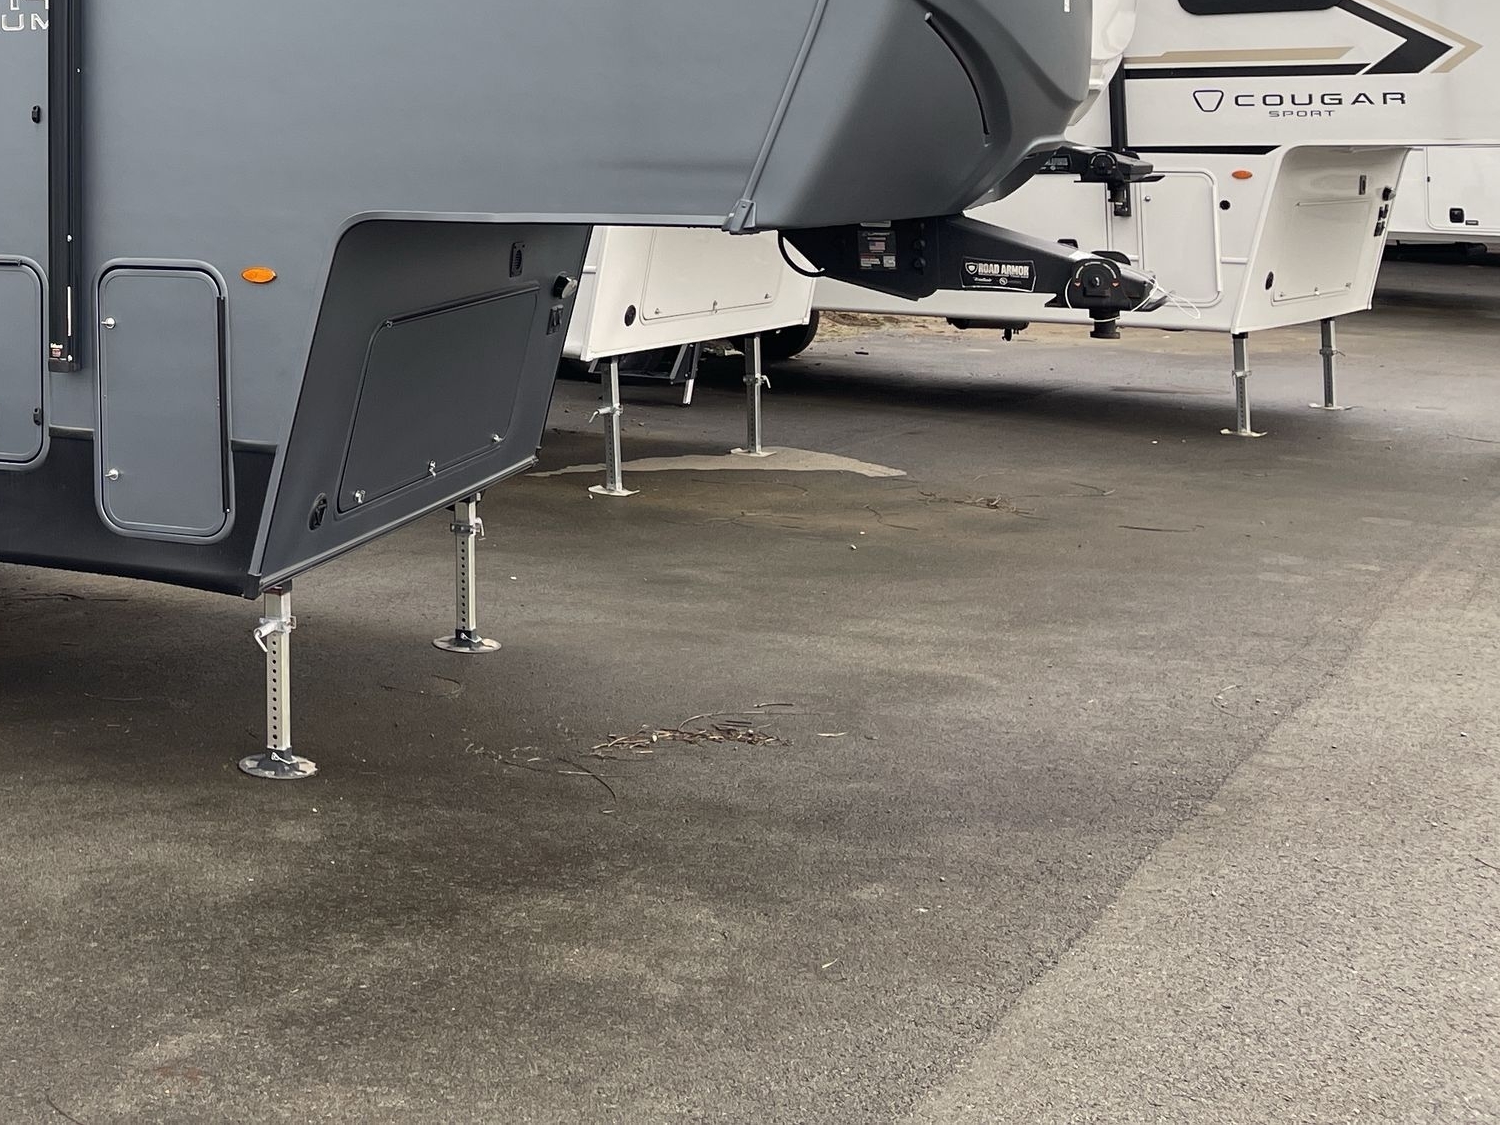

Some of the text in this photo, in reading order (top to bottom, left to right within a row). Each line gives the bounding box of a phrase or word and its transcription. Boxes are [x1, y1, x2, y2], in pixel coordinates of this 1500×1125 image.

[1234, 91, 1406, 107] COUGAR
[1268, 109, 1336, 118] SPORT
[978, 263, 1029, 276] ROAD ARMOR
